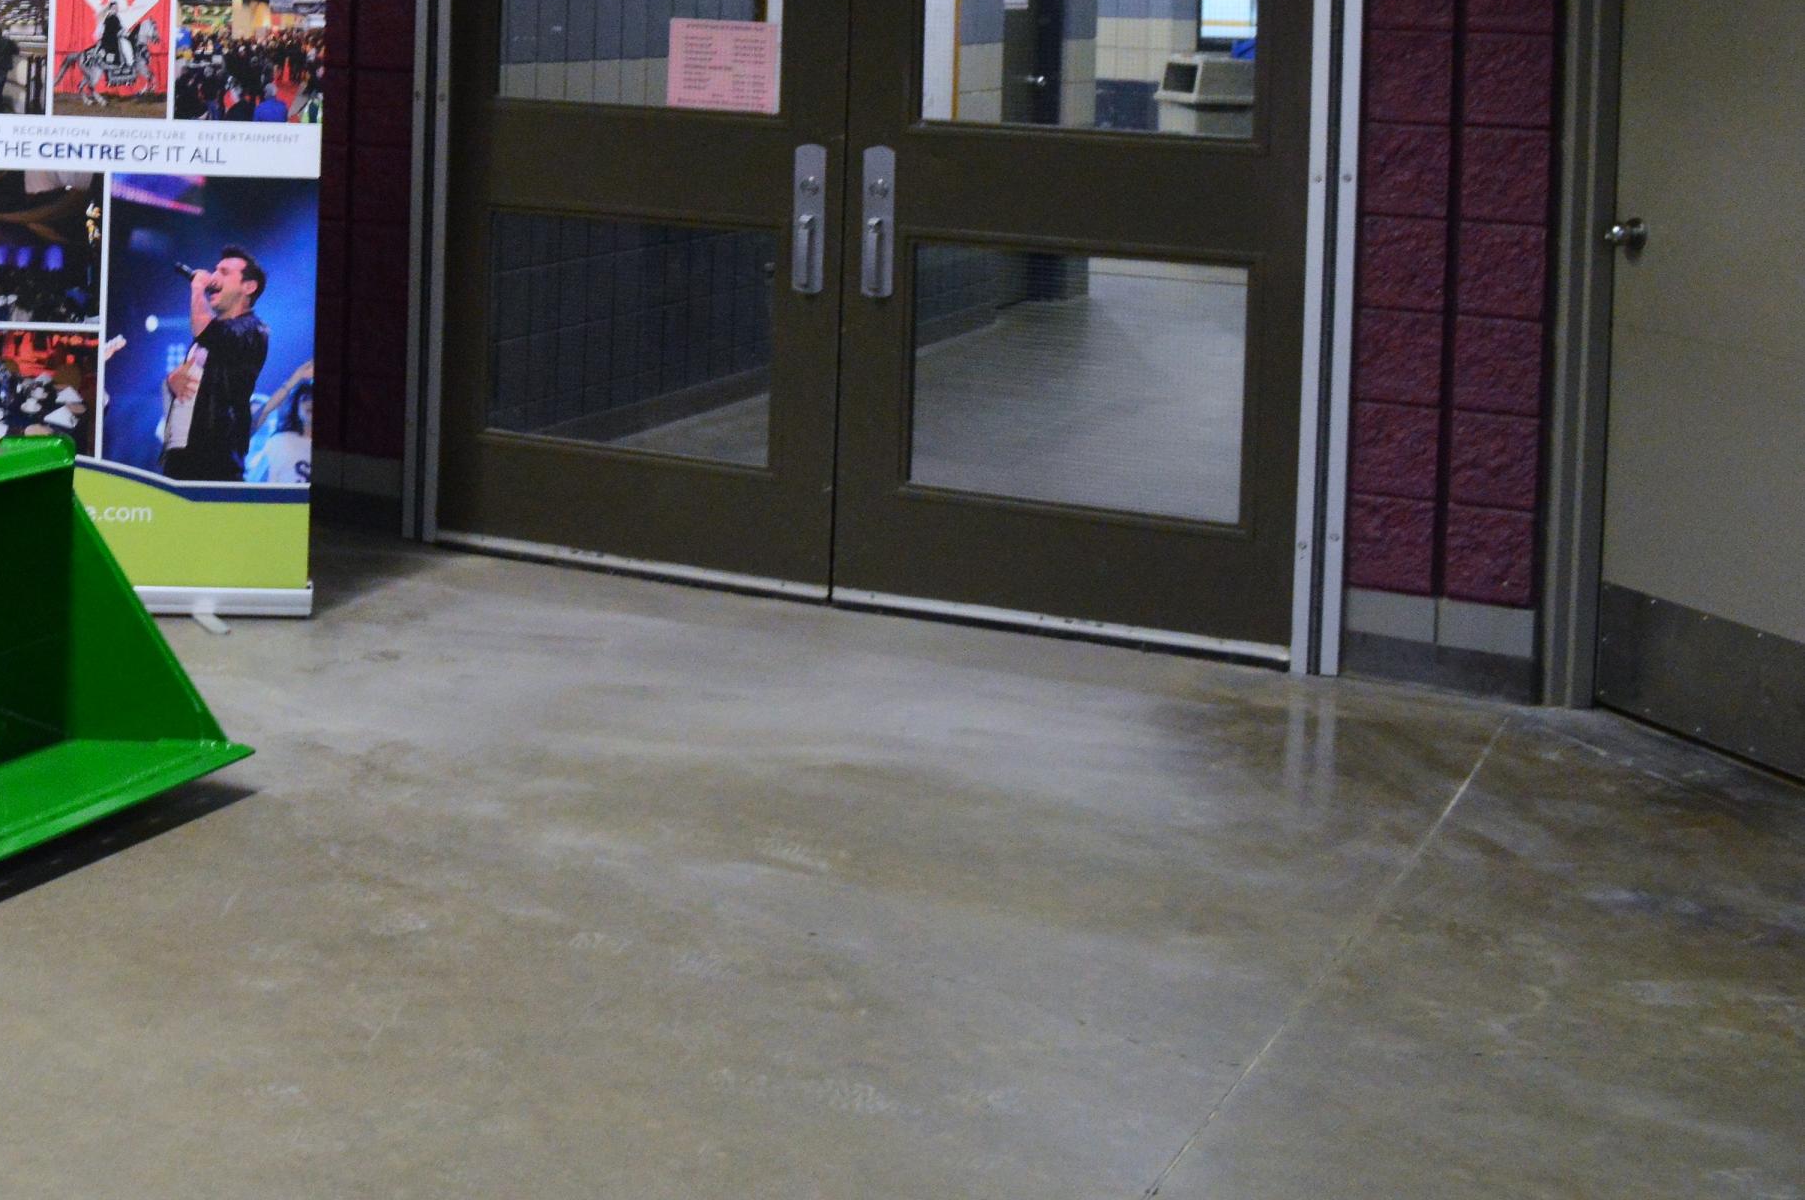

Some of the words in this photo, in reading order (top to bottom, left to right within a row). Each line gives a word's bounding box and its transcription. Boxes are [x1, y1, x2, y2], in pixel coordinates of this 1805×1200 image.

[12, 126, 91, 138] RECREATION
[101, 128, 186, 141] AGRICULTURE
[197, 130, 300, 144] ENTERTAINMENT
[38, 142, 126, 161] CENTRE
[131, 144, 160, 162] OF
[166, 146, 185, 162] IT
[189, 146, 227, 165] ALL
